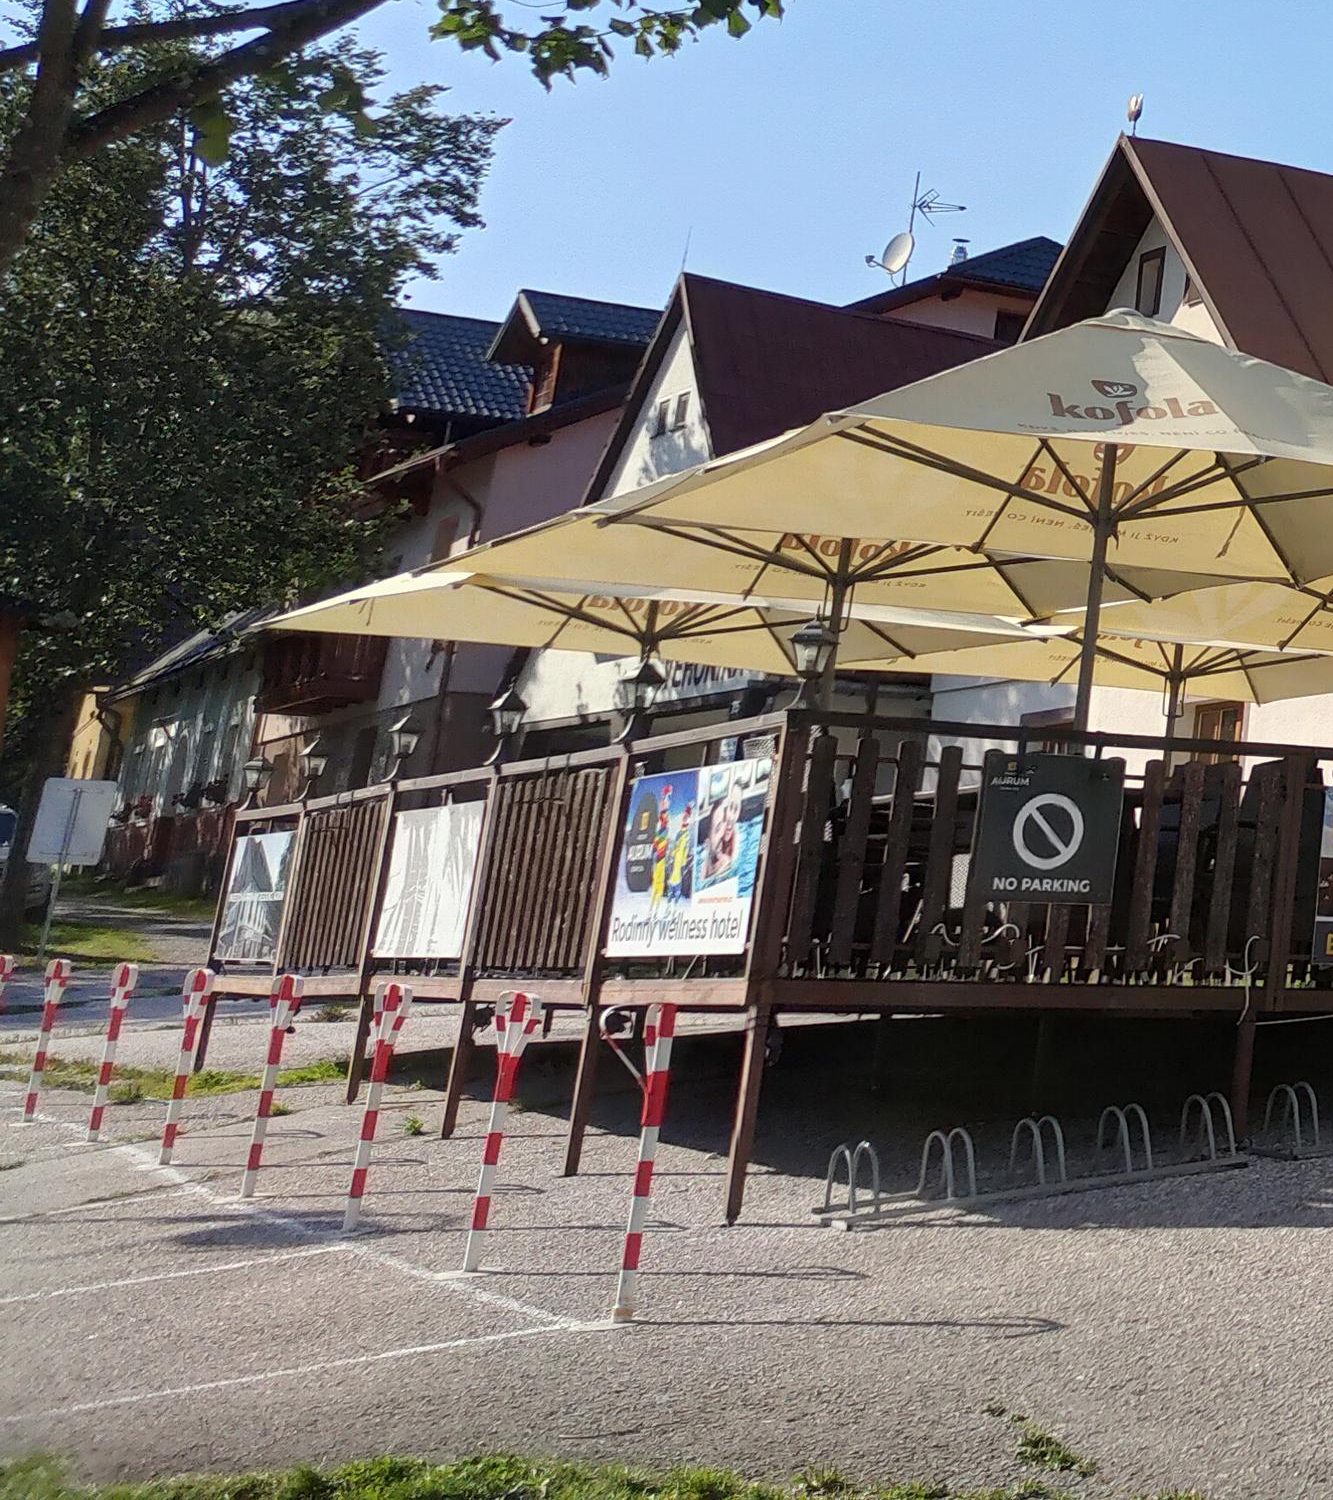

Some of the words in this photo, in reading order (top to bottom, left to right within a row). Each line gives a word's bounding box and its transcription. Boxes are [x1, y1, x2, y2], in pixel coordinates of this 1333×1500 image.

[1047, 392, 1219, 426] kofola
[990, 776, 1030, 786] AURUM
[992, 877, 1018, 891] NO
[1021, 878, 1091, 893] PARKING
[710, 909, 744, 940] hotel
